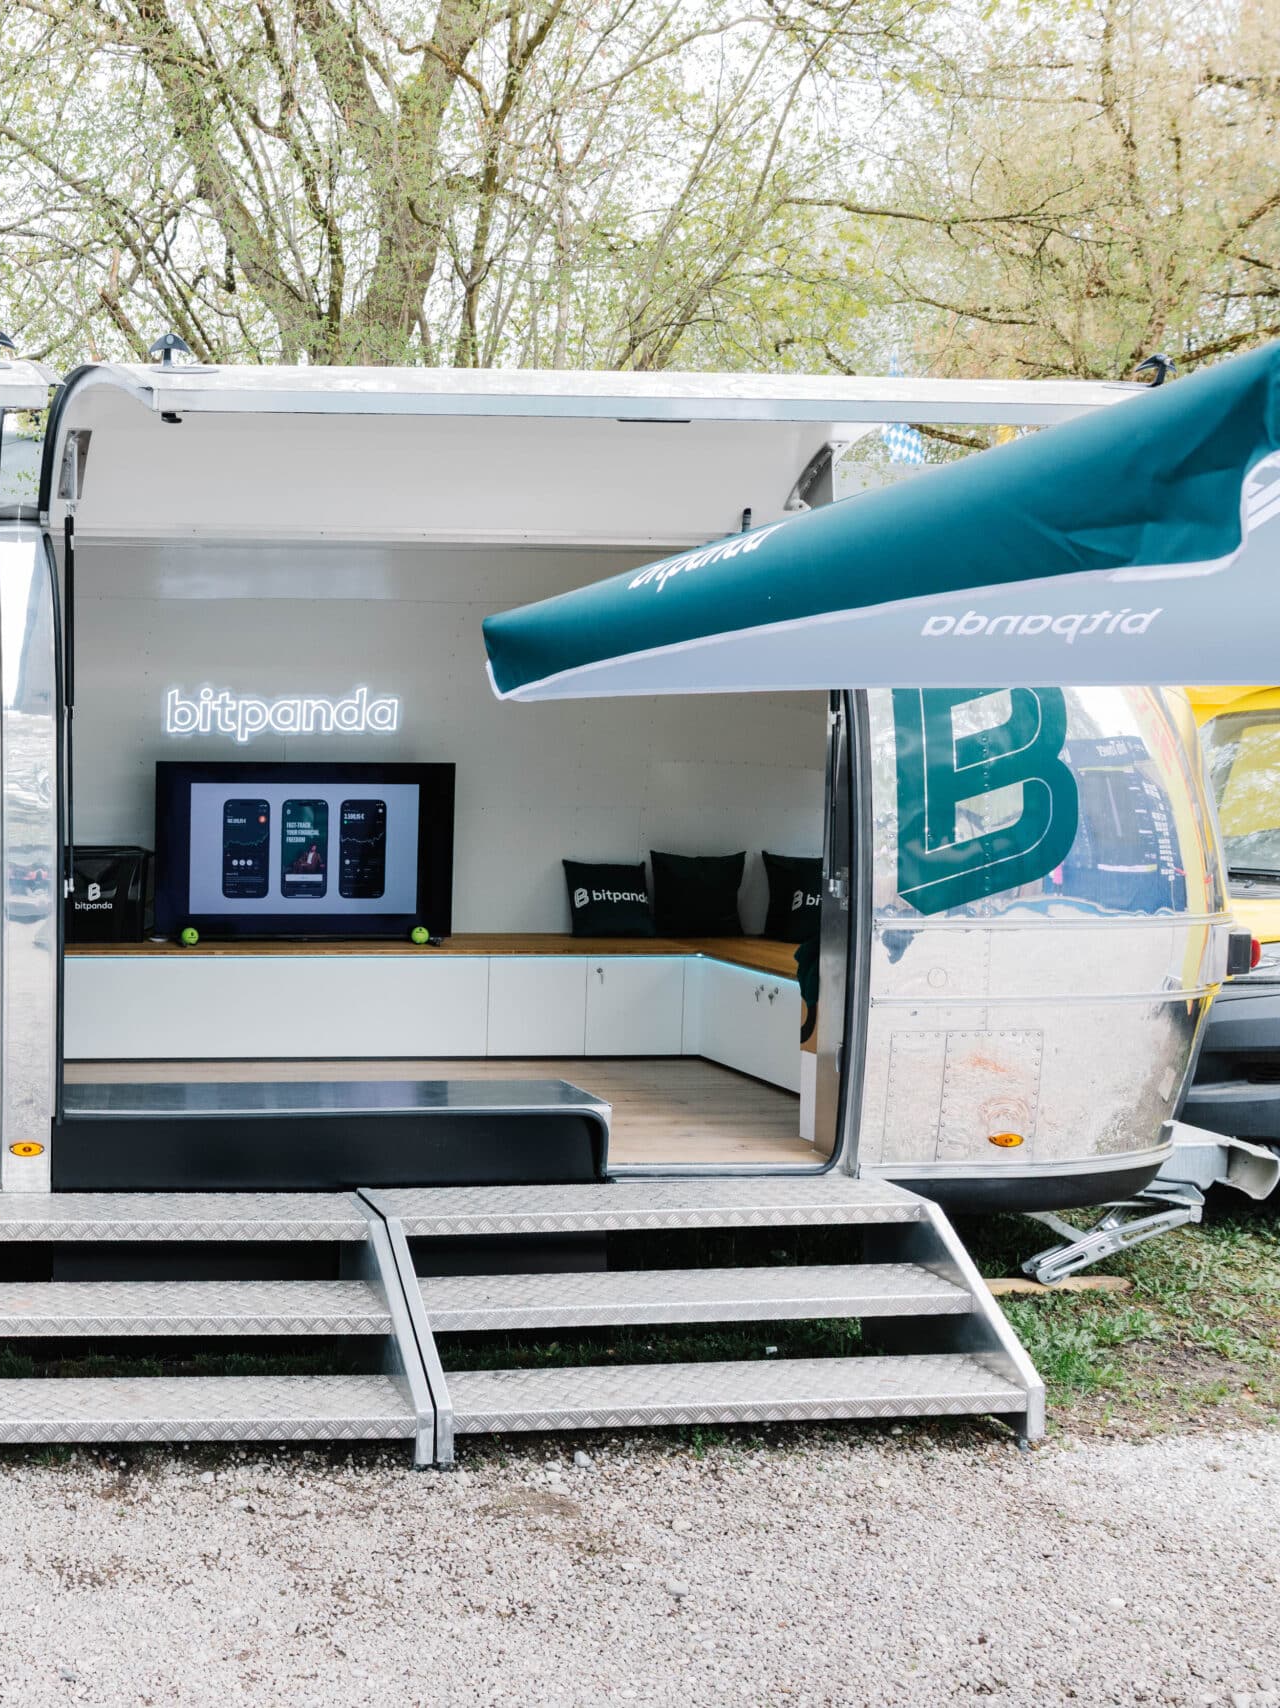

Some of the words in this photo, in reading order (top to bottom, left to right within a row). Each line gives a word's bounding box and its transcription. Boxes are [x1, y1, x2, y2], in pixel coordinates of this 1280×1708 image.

[166, 687, 399, 742] bitpanda
[74, 901, 113, 911] bitpanda
[806, 893, 823, 906] bi
